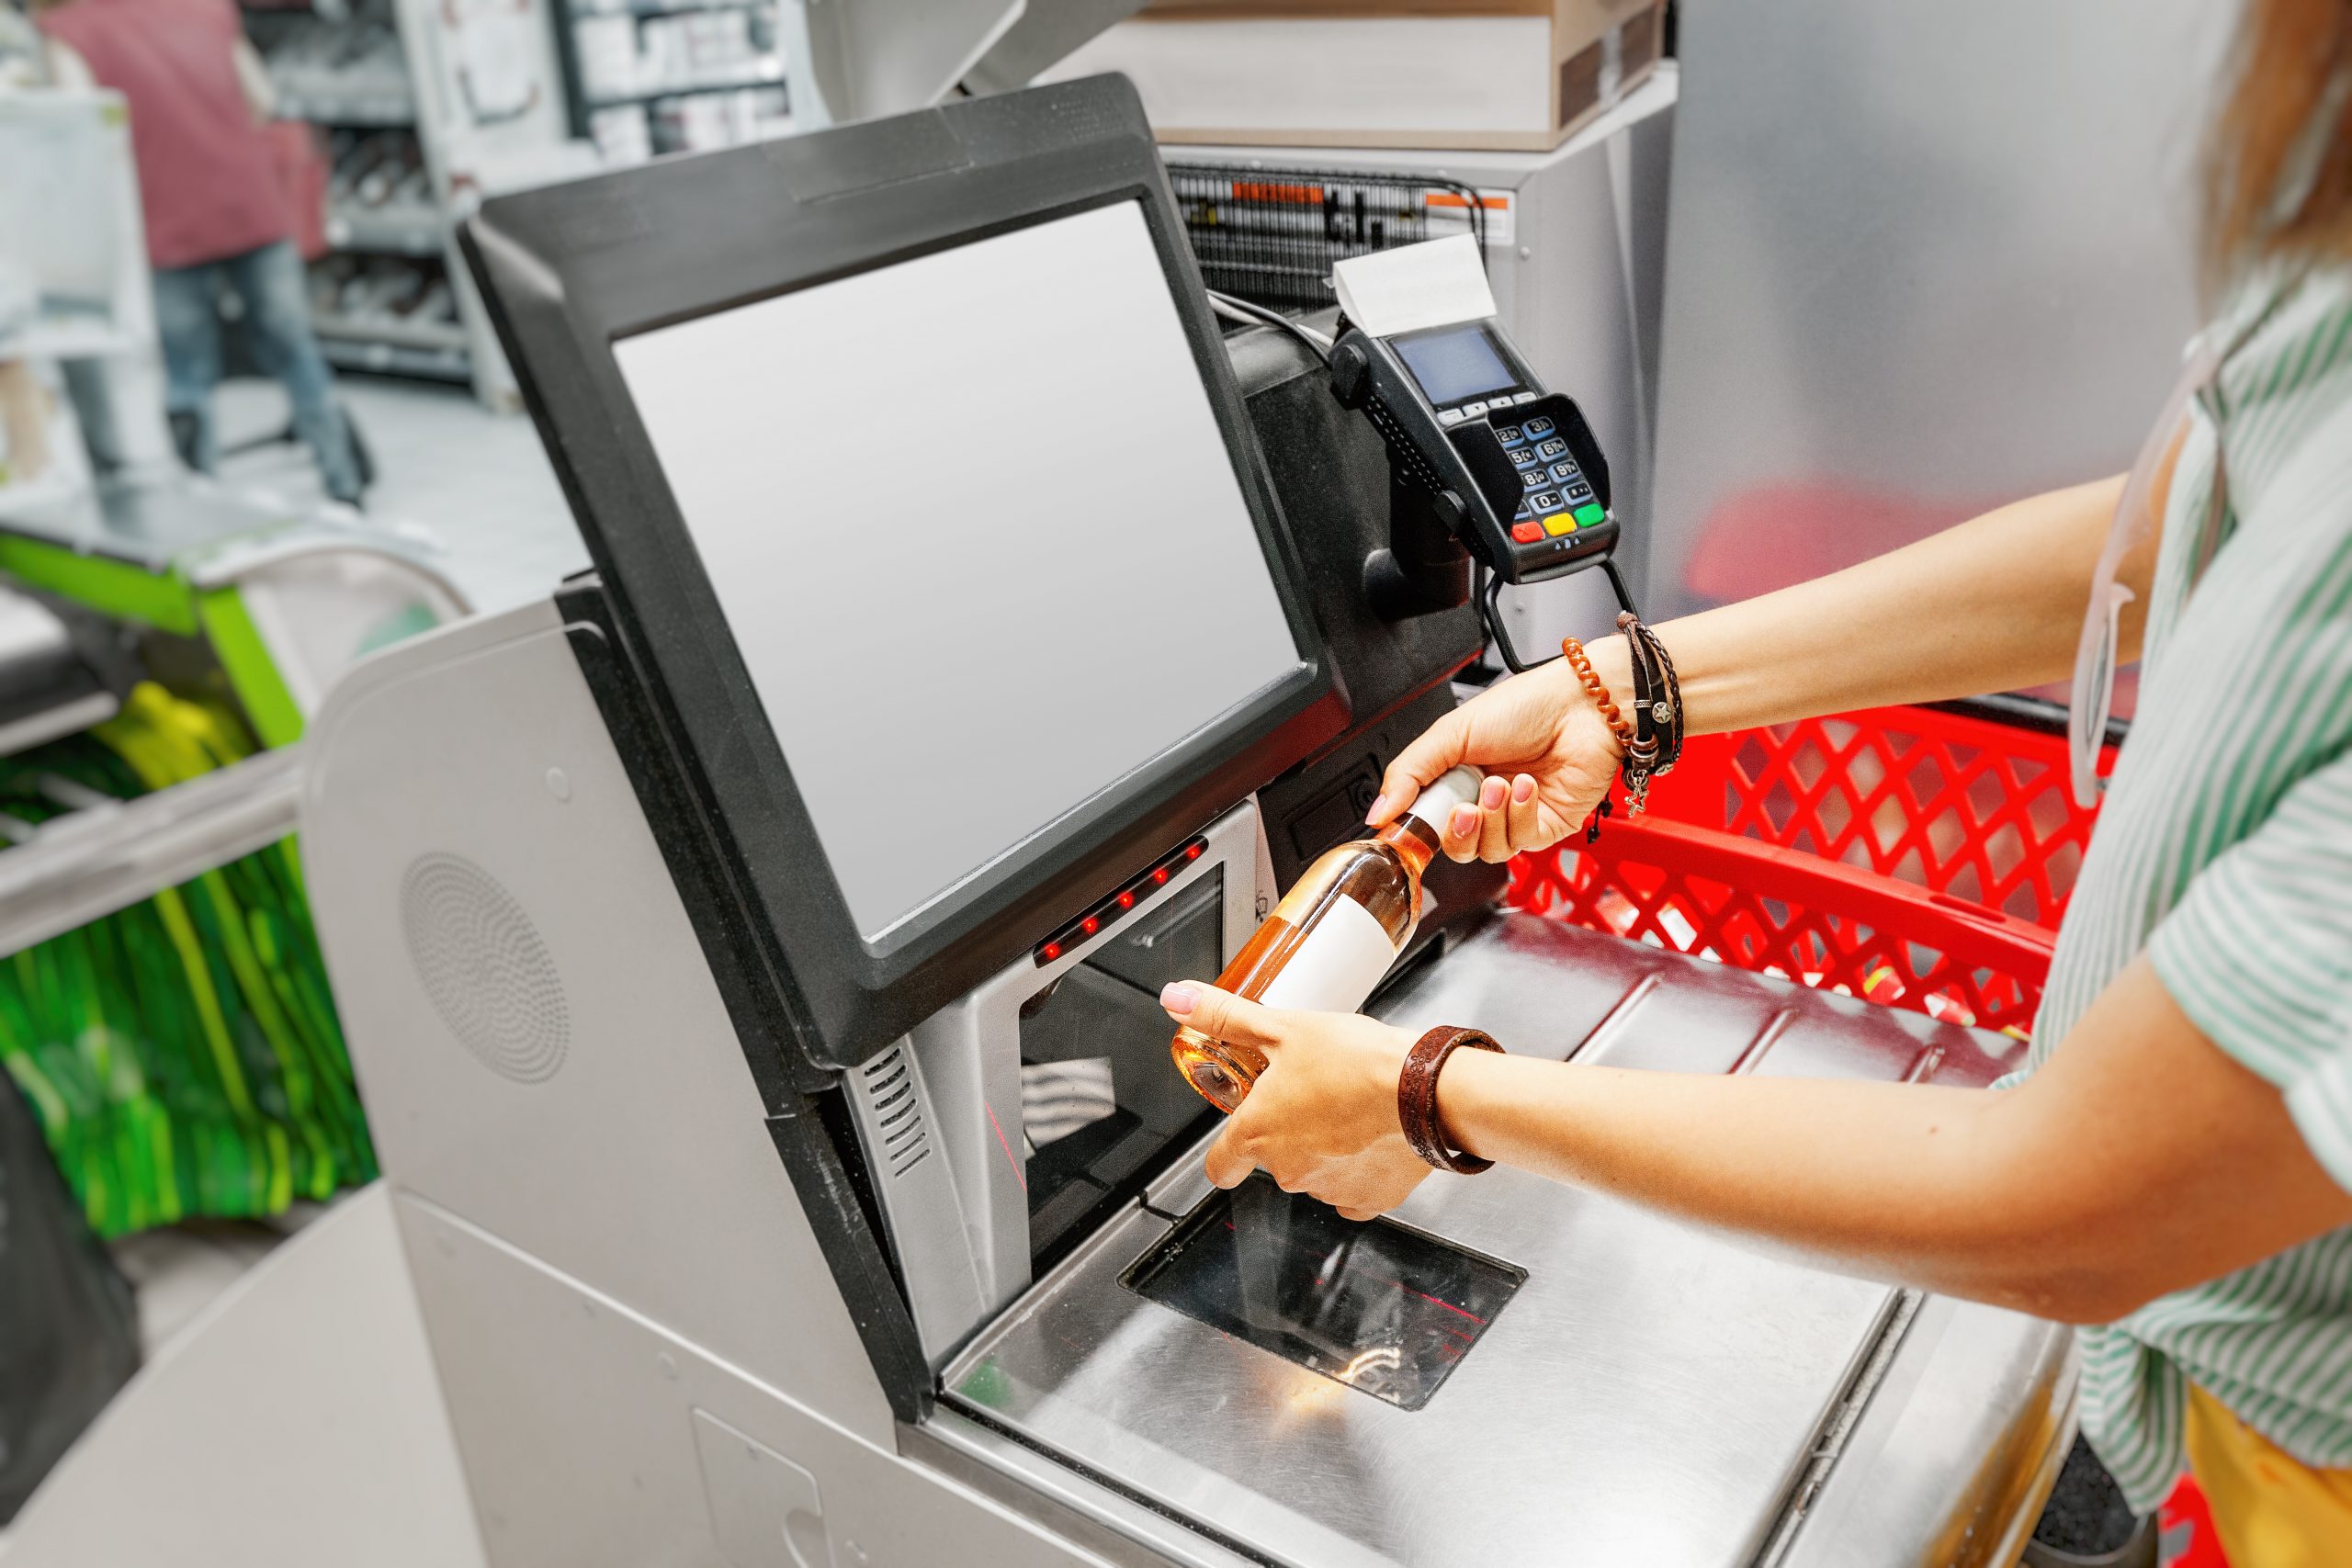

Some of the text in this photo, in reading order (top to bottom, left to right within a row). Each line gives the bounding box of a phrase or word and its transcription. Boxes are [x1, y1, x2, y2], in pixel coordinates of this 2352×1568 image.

[1531, 422, 1543, 432] 3
[1498, 431, 1510, 442] 2
[1544, 444, 1555, 455] 6
[1511, 452, 1523, 464] 5
[1556, 465, 1567, 476] 9
[1524, 474, 1536, 485] 8
[1539, 495, 1551, 507] 0
